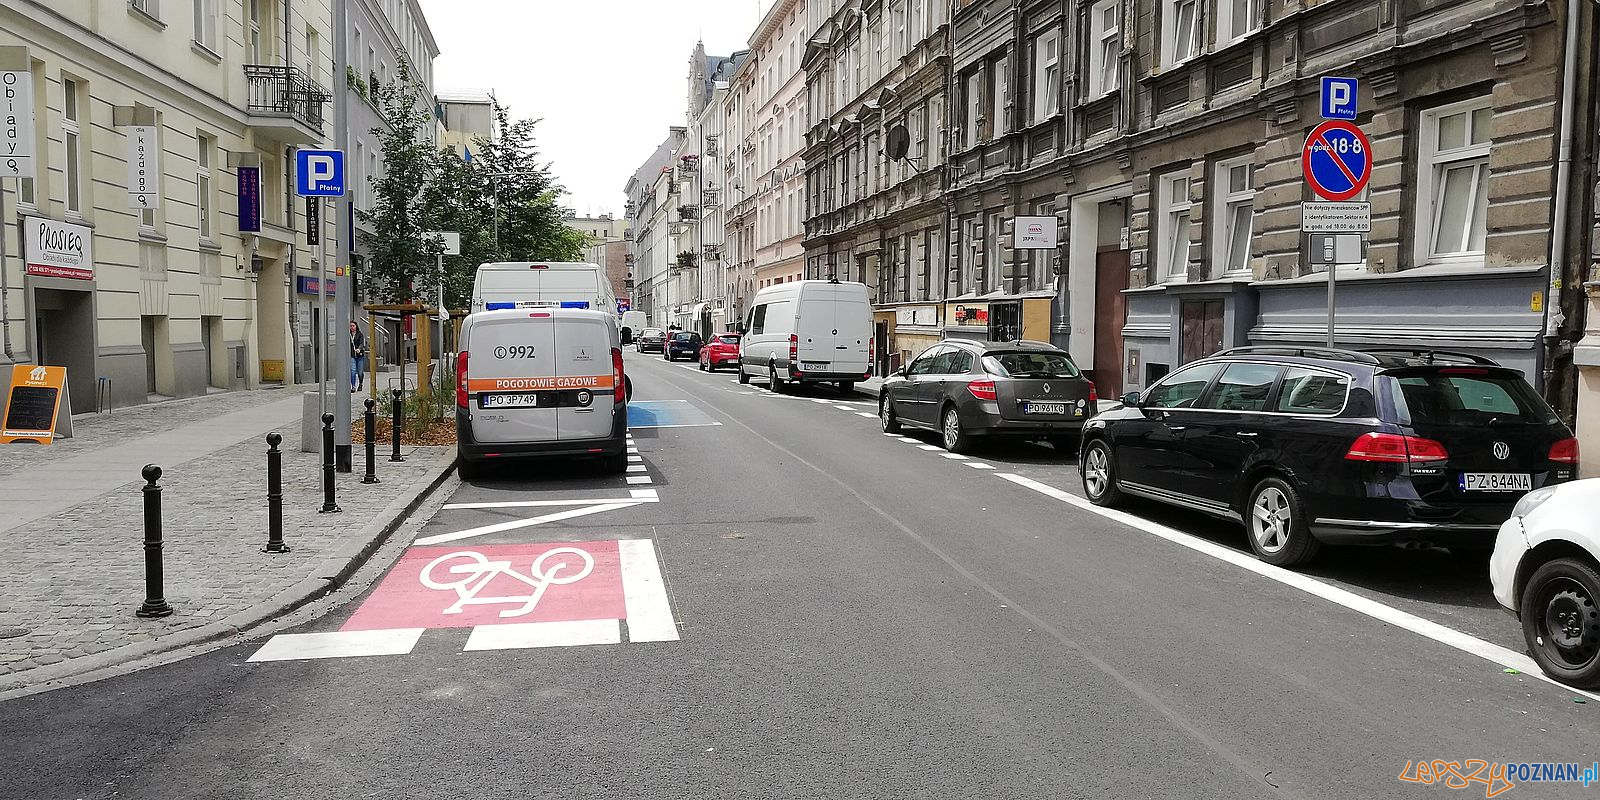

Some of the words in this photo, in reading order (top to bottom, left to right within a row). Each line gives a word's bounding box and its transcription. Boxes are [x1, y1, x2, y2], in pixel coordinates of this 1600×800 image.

[1330, 82, 1350, 113] P
[3, 72, 17, 155] Obiady
[1332, 138, 1361, 153] 18-8
[308, 155, 334, 190] P
[320, 184, 340, 192] Płatny
[509, 346, 536, 359] 992
[496, 378, 555, 389] POGOTOWIE
[557, 377, 597, 387] GAZOWE
[489, 396, 504, 405] PO
[506, 395, 535, 405] 3P749
[1042, 404, 1064, 412] 961KG
[1467, 474, 1486, 488] PZ
[1491, 474, 1530, 489] 844NA
